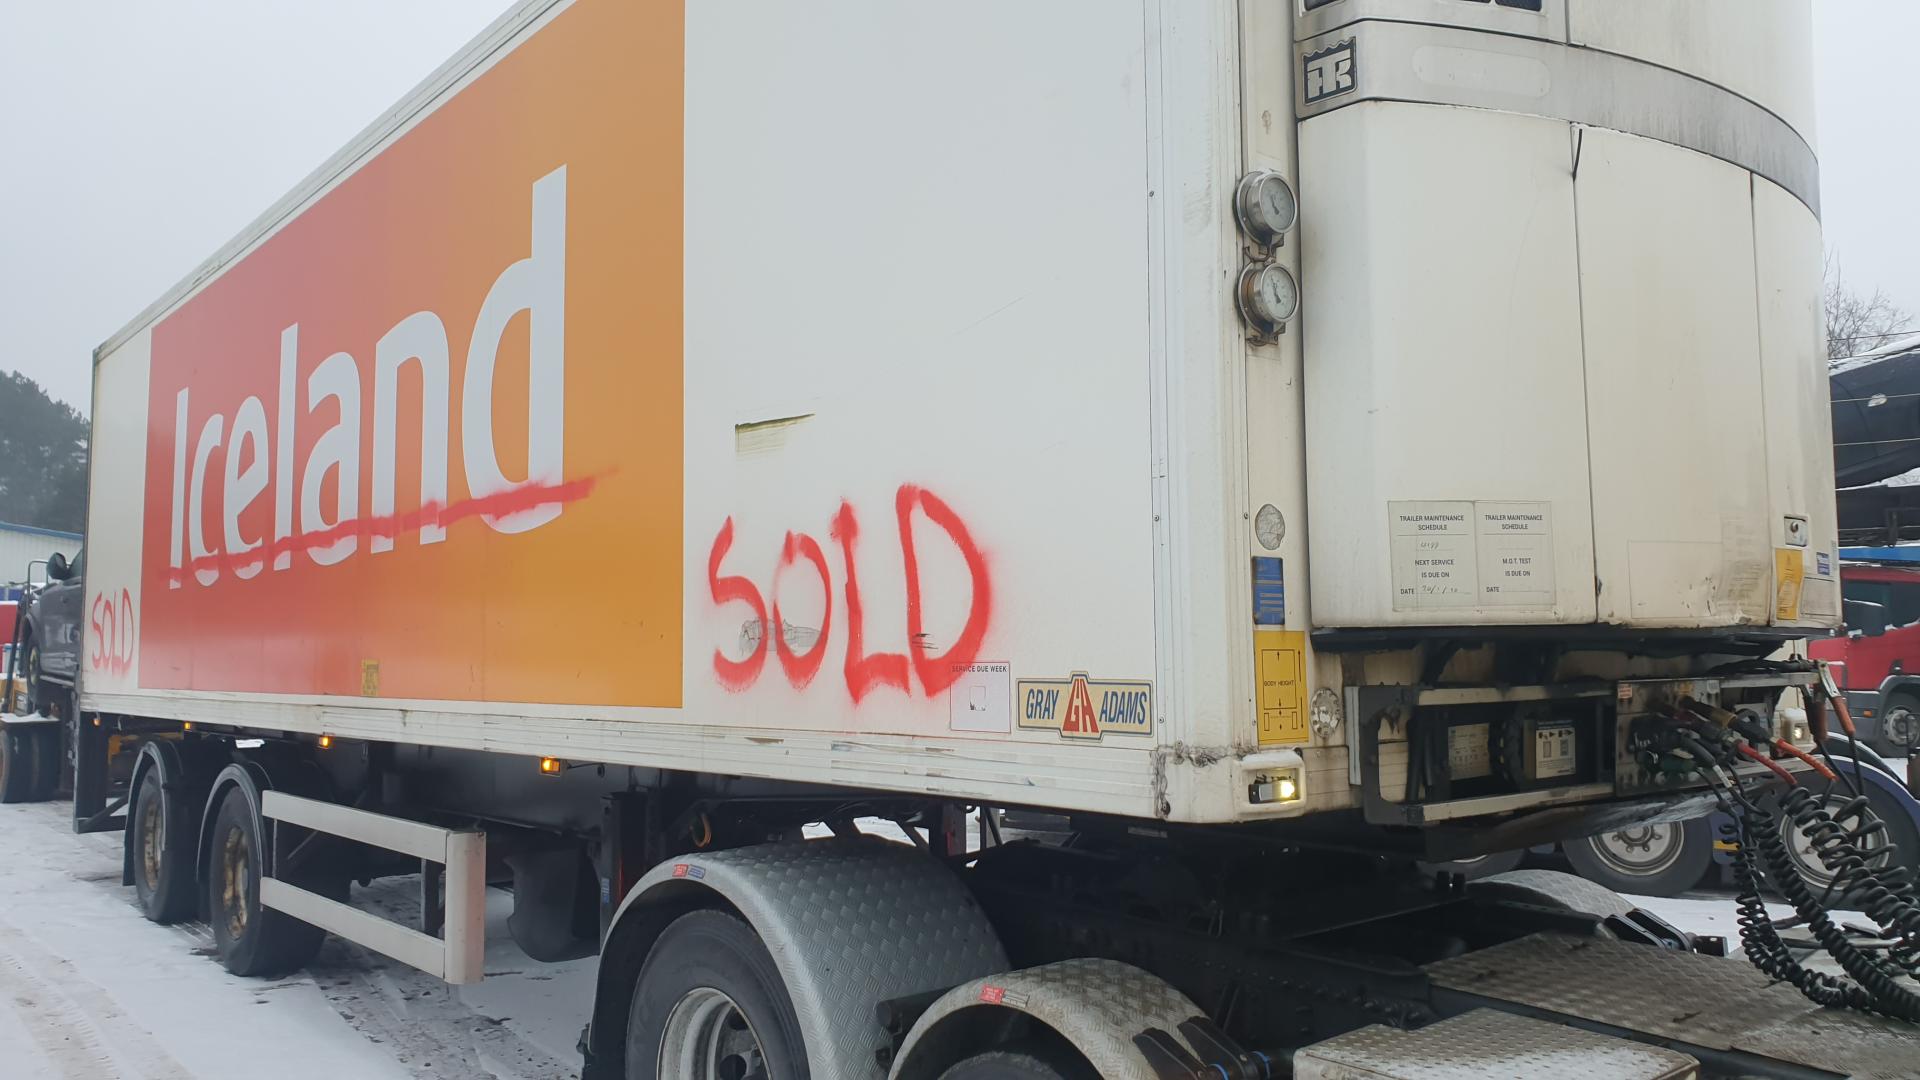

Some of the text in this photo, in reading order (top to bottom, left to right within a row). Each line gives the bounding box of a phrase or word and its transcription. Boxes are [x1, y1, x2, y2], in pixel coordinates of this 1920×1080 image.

[169, 163, 567, 589] Iceland
[92, 587, 135, 675] SOLD
[708, 481, 993, 706] SOLD
[952, 665, 1007, 673] SERVICE DUE WEEK
[1026, 688, 1060, 720] GRAY
[1099, 690, 1147, 725] ADAMS
